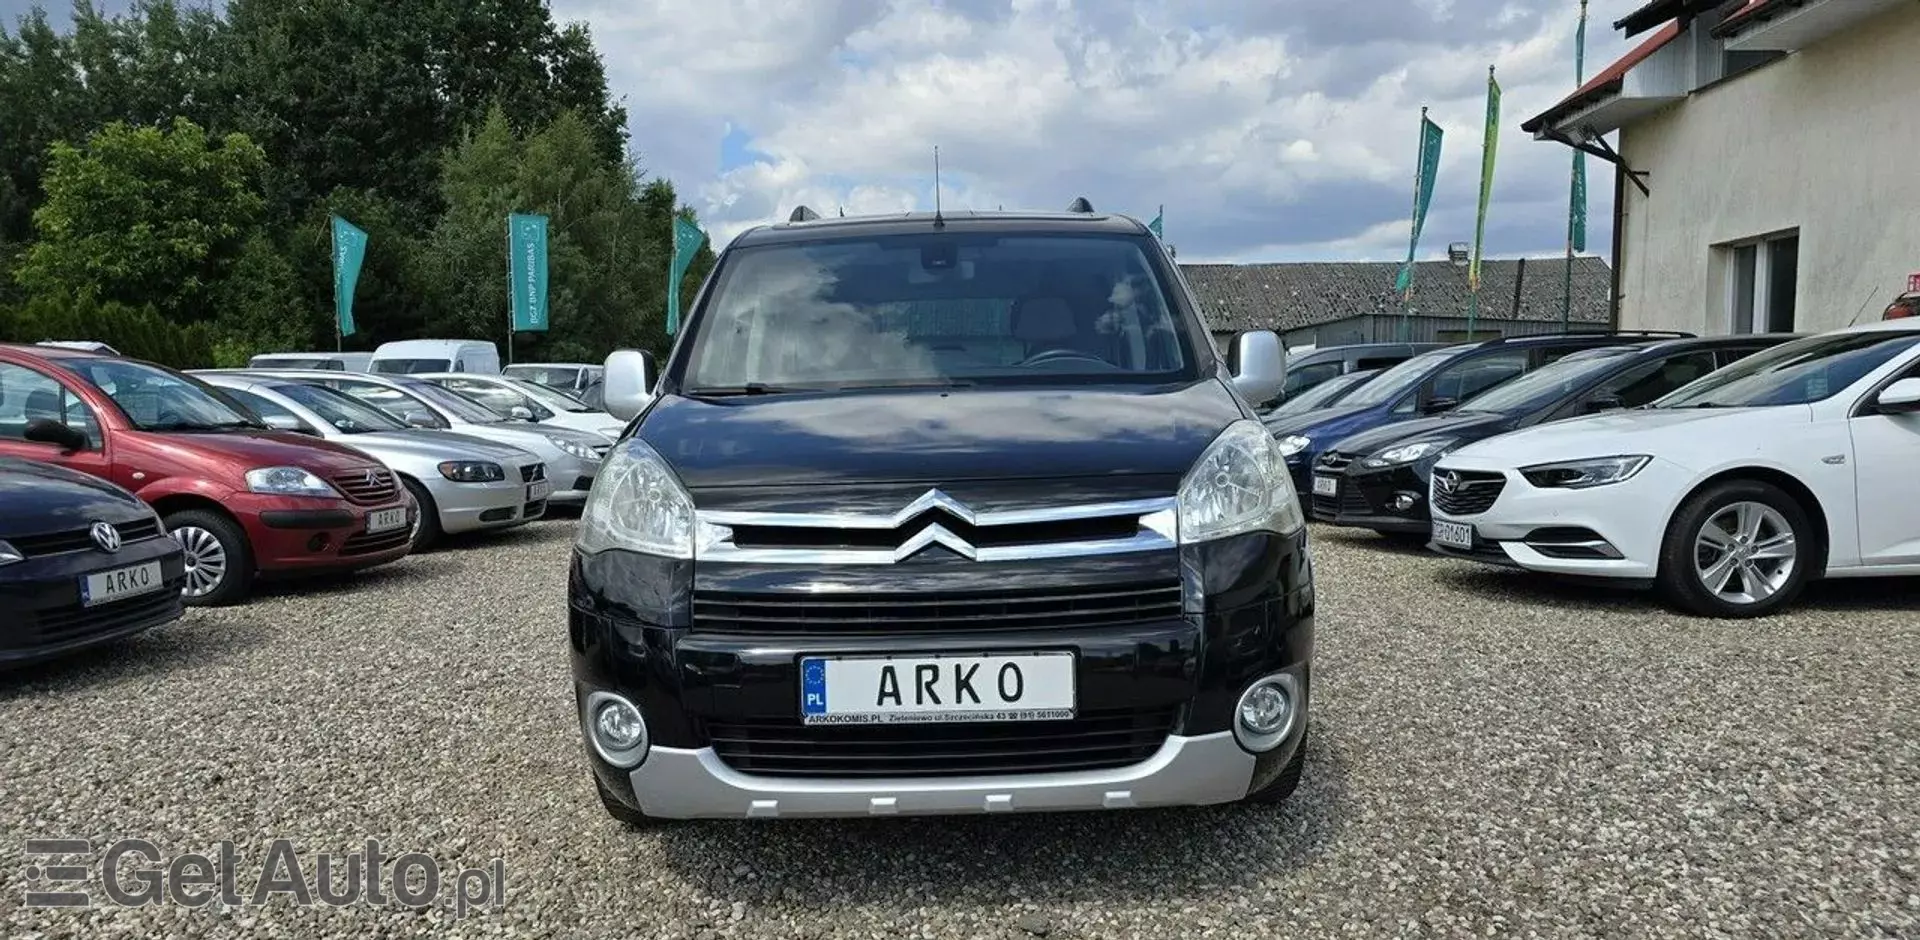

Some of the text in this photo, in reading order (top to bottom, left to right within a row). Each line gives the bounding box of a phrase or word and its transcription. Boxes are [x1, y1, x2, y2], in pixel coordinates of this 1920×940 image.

[526, 243, 536, 282] PARIBAS
[106, 567, 149, 594] ARKO
[877, 662, 1023, 706] ARKO
[807, 693, 824, 706] PL
[808, 713, 883, 723] ARKOKOMIS.PL
